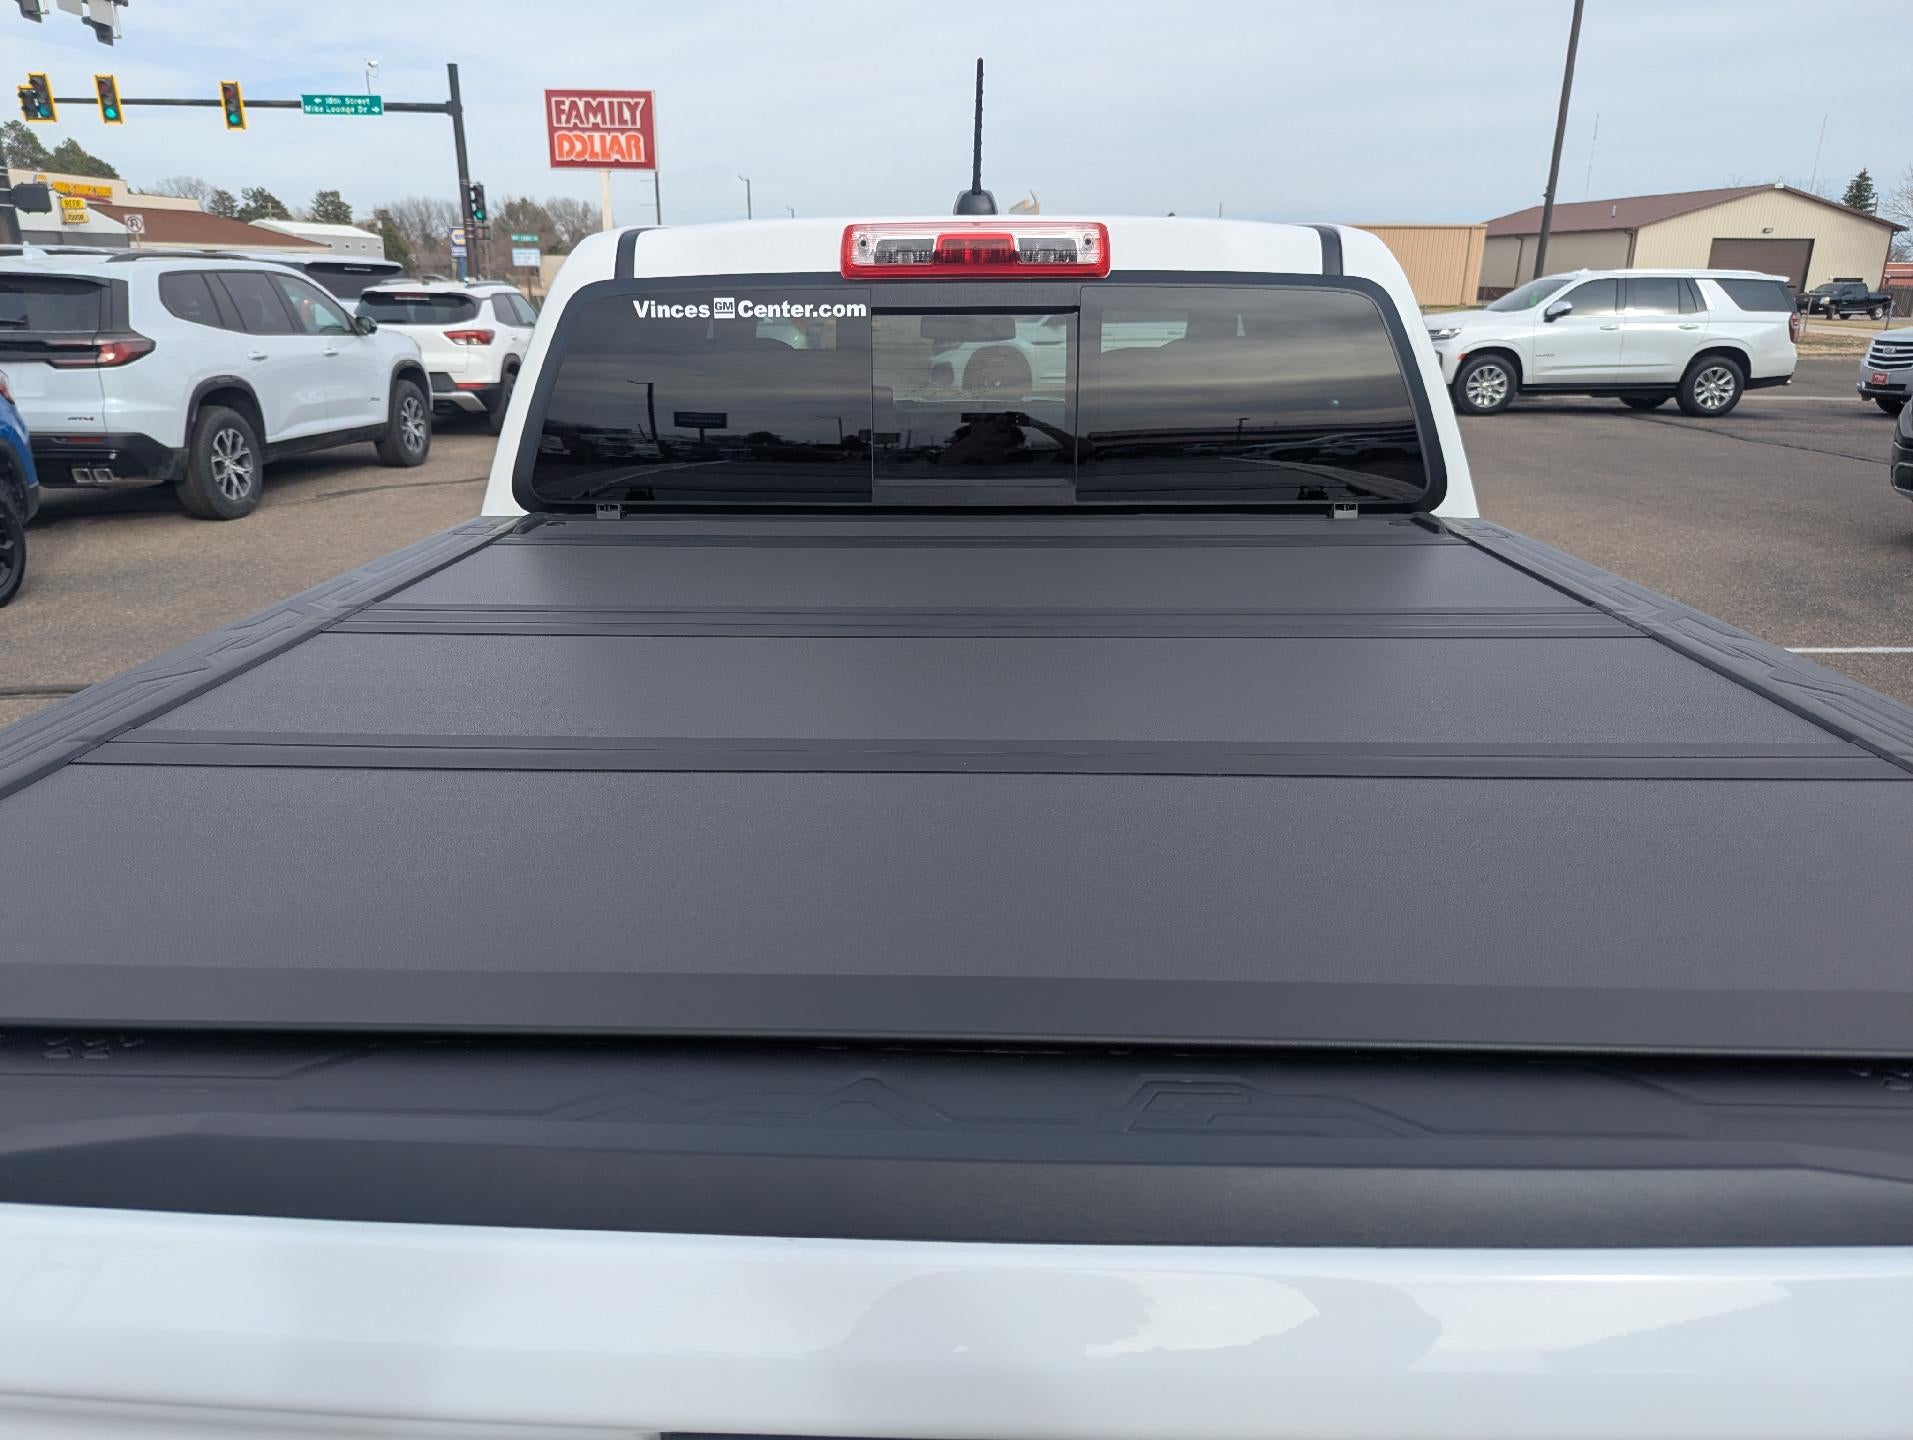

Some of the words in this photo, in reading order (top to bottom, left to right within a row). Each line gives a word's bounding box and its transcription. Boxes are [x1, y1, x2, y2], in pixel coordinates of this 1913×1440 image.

[345, 97, 370, 105] Street
[551, 97, 646, 128] FAMILY
[554, 131, 645, 162] DOLLAR
[633, 300, 710, 318] Vinces
[714, 300, 734, 311] GM
[738, 300, 867, 317] Center.com
